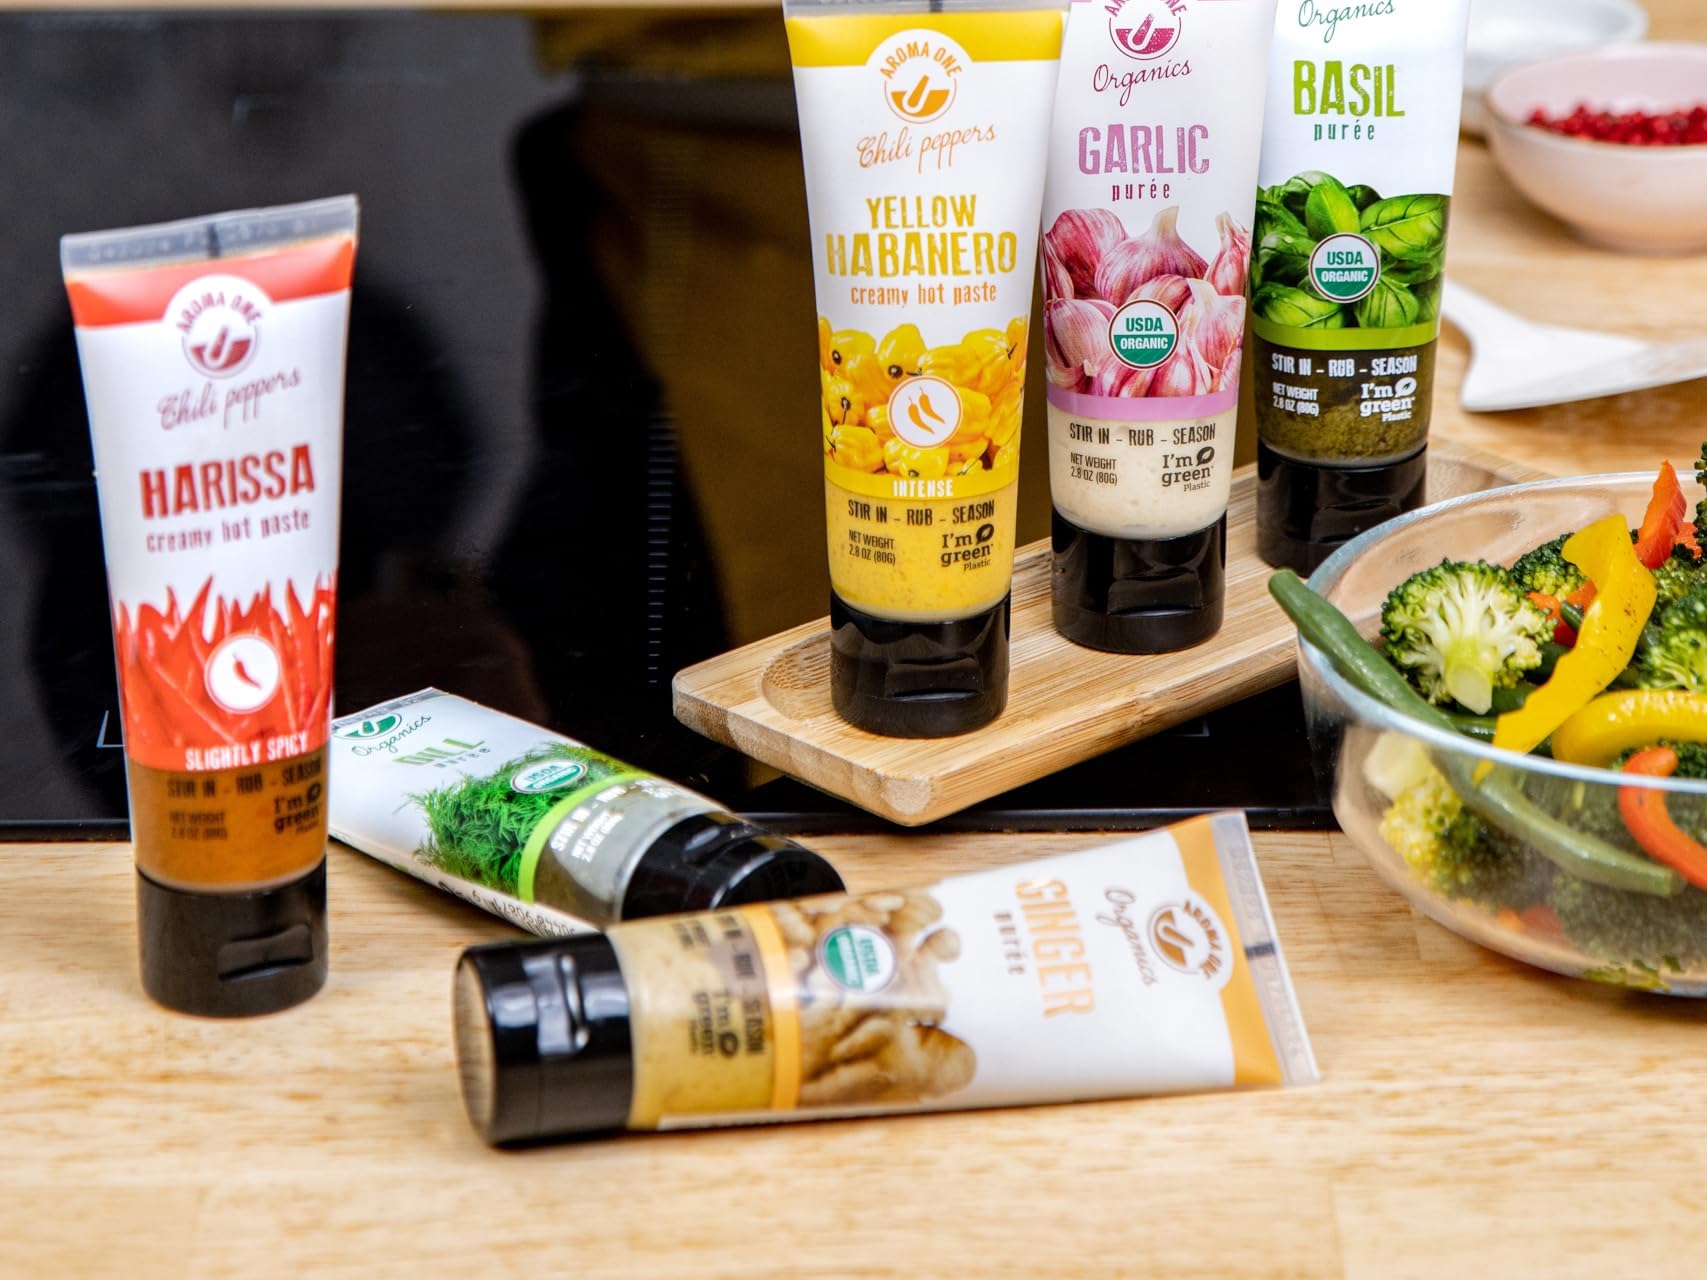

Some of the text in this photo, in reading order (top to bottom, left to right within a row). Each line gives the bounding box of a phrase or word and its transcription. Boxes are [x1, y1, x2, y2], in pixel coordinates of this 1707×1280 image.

[880, 41, 962, 79] AROMA ONE
[1093, 59, 1192, 107] Organics
[1293, 60, 1405, 117] BASIL
[1314, 120, 1375, 142] purée
[856, 123, 996, 174] Chili peppers
[1078, 123, 1210, 175] GARLIC
[1112, 179, 1170, 202] purée
[865, 194, 977, 229] YELLOW
[825, 230, 1017, 278] HABANERO
[1327, 251, 1363, 265] USDA
[1321, 269, 1368, 283] ORGANIC
[850, 281, 997, 308] creamy hot paste
[175, 291, 226, 335] AROMA
[1126, 317, 1163, 331] USDA
[1120, 337, 1168, 350] ORGANIC
[1272, 353, 1295, 374] STIR
[1298, 358, 1312, 376] IN
[1328, 358, 1355, 377] RUB
[1371, 355, 1418, 376] SEASON
[157, 368, 301, 431] Chili peppers
[1361, 383, 1393, 399] I'm
[1360, 398, 1412, 417] green
[1070, 422, 1093, 442] STIR
[1098, 427, 1110, 445] IN
[1129, 429, 1154, 446] RUB
[1173, 422, 1216, 445] SEASON
[1070, 452, 1117, 470] NET WEIGHT
[1162, 453, 1193, 469] I'm
[139, 443, 316, 520] HARISSA
[1071, 466, 1118, 486] 2.8 OZ (80G)
[1162, 467, 1211, 487] green
[1184, 480, 1210, 492] Plastic
[892, 479, 954, 498] INTENSE
[848, 499, 871, 520] STIR
[876, 505, 888, 523] IN
[906, 508, 933, 526] RUB
[952, 499, 995, 525] SEASON
[146, 510, 310, 553] creamy hot paste
[849, 529, 895, 550] NET WEIGHT
[941, 532, 972, 549] I'm
[849, 543, 896, 567] 2.8 OZ (80G)
[941, 545, 991, 567] green
[963, 558, 991, 573] Plastic
[352, 714, 432, 757] Organics
[185, 731, 308, 771] SLIGHTLY SPICY
[1096, 887, 1159, 986] Organics
[1014, 879, 1095, 1019] GINGER
